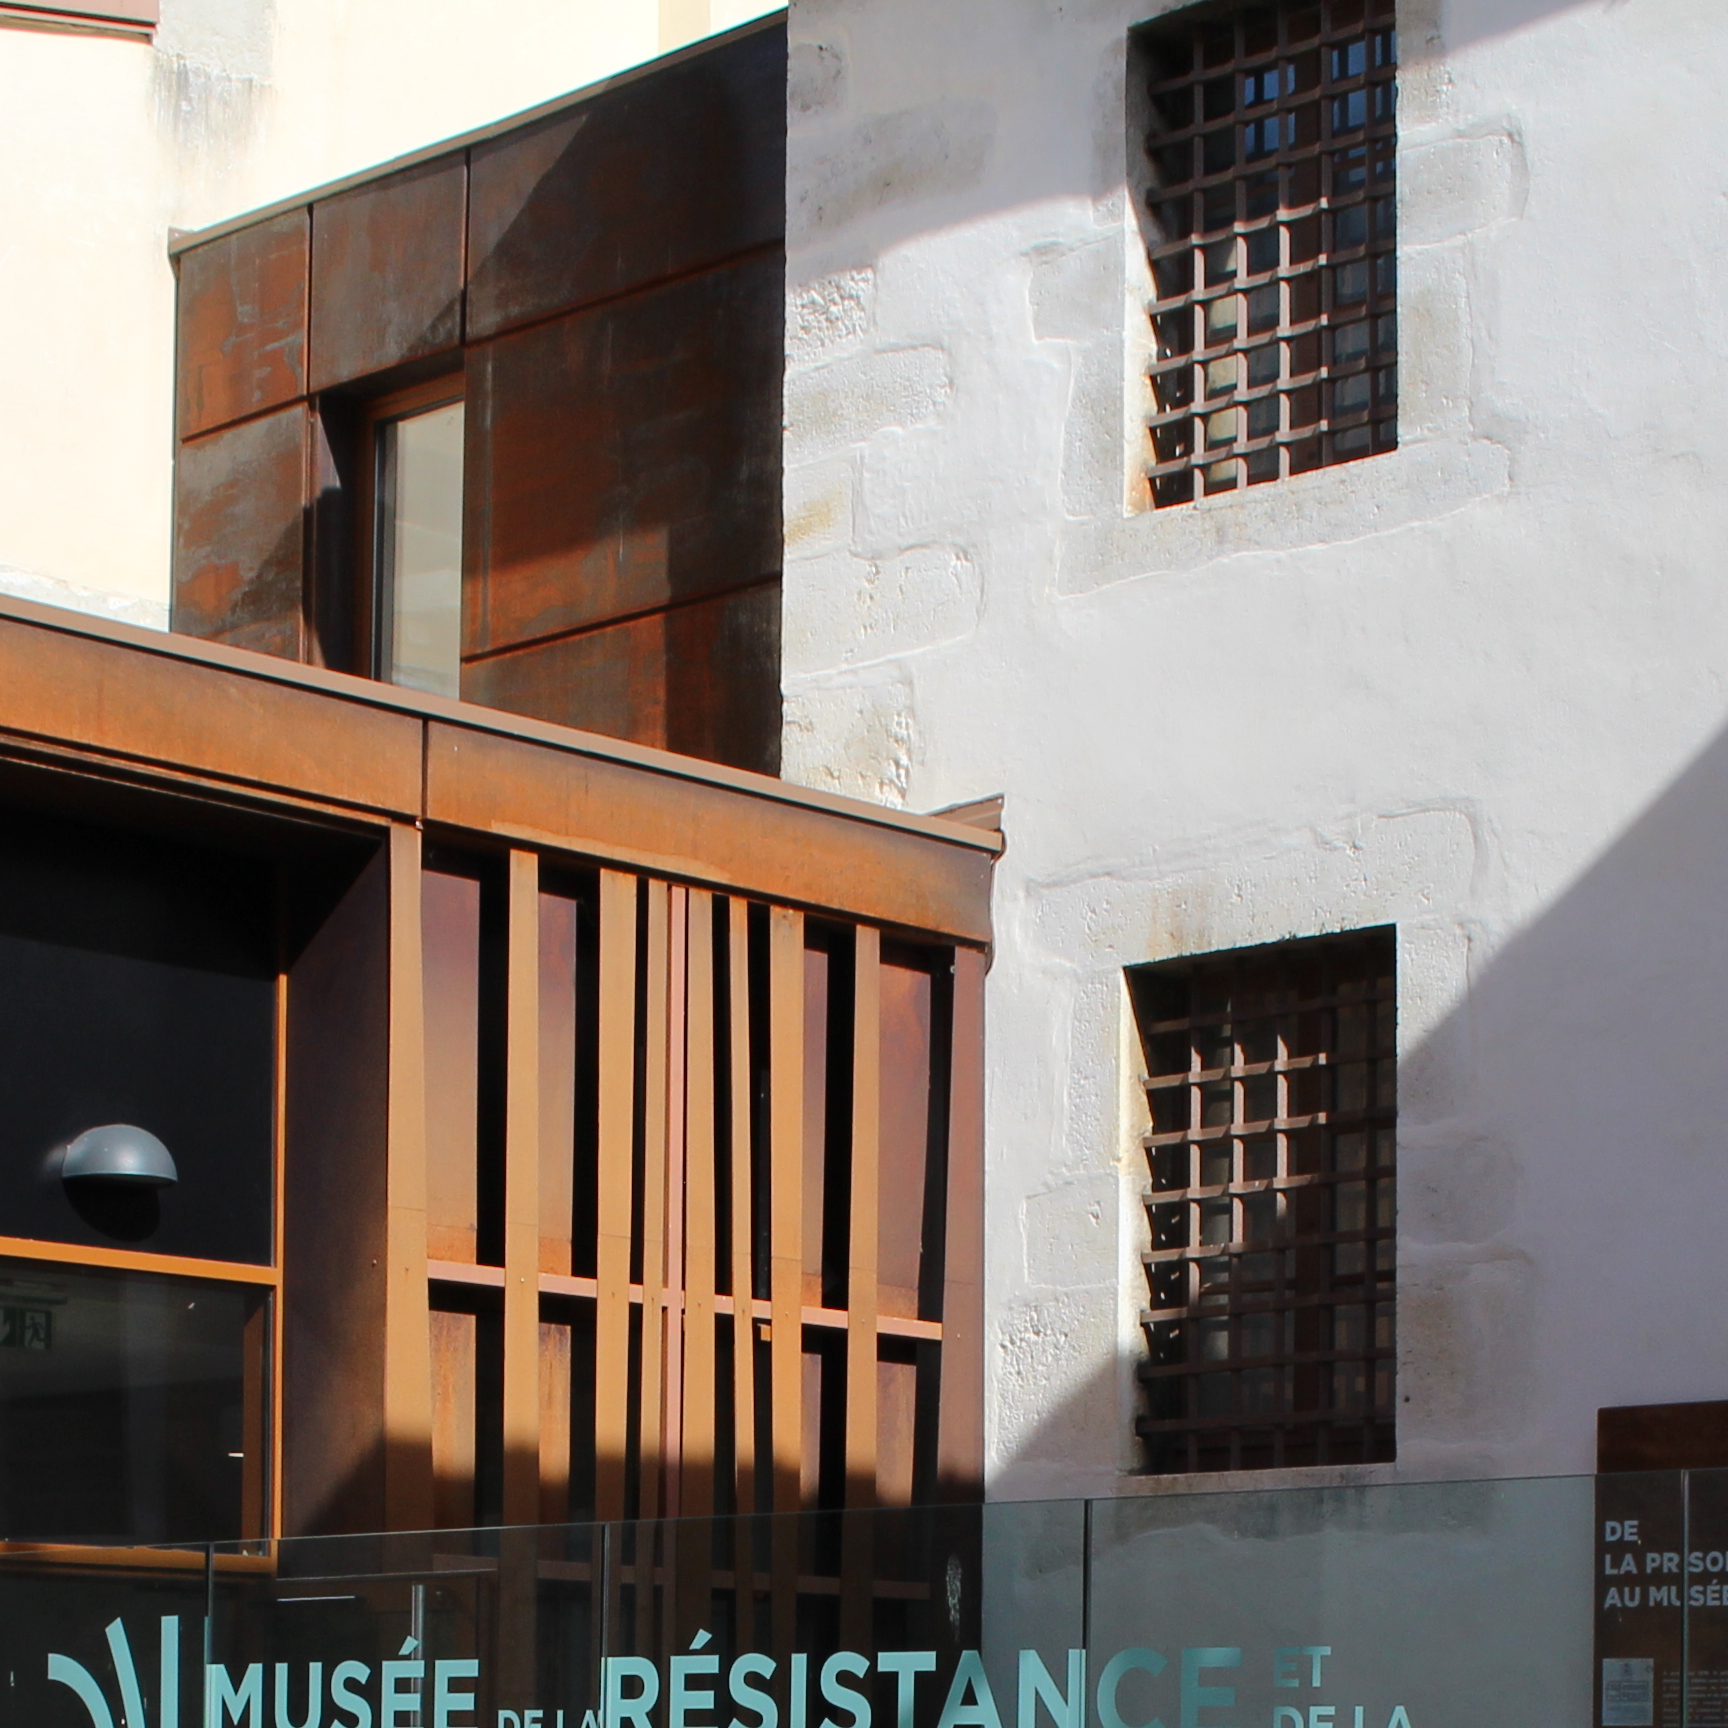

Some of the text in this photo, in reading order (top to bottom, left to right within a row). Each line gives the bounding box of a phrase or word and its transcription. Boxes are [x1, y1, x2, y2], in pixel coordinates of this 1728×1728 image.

[1605, 1520, 1639, 1542] DE
[1605, 1553, 1637, 1575] LA
[1604, 1586, 1641, 1608] AU
[1275, 1646, 1331, 1687] ET
